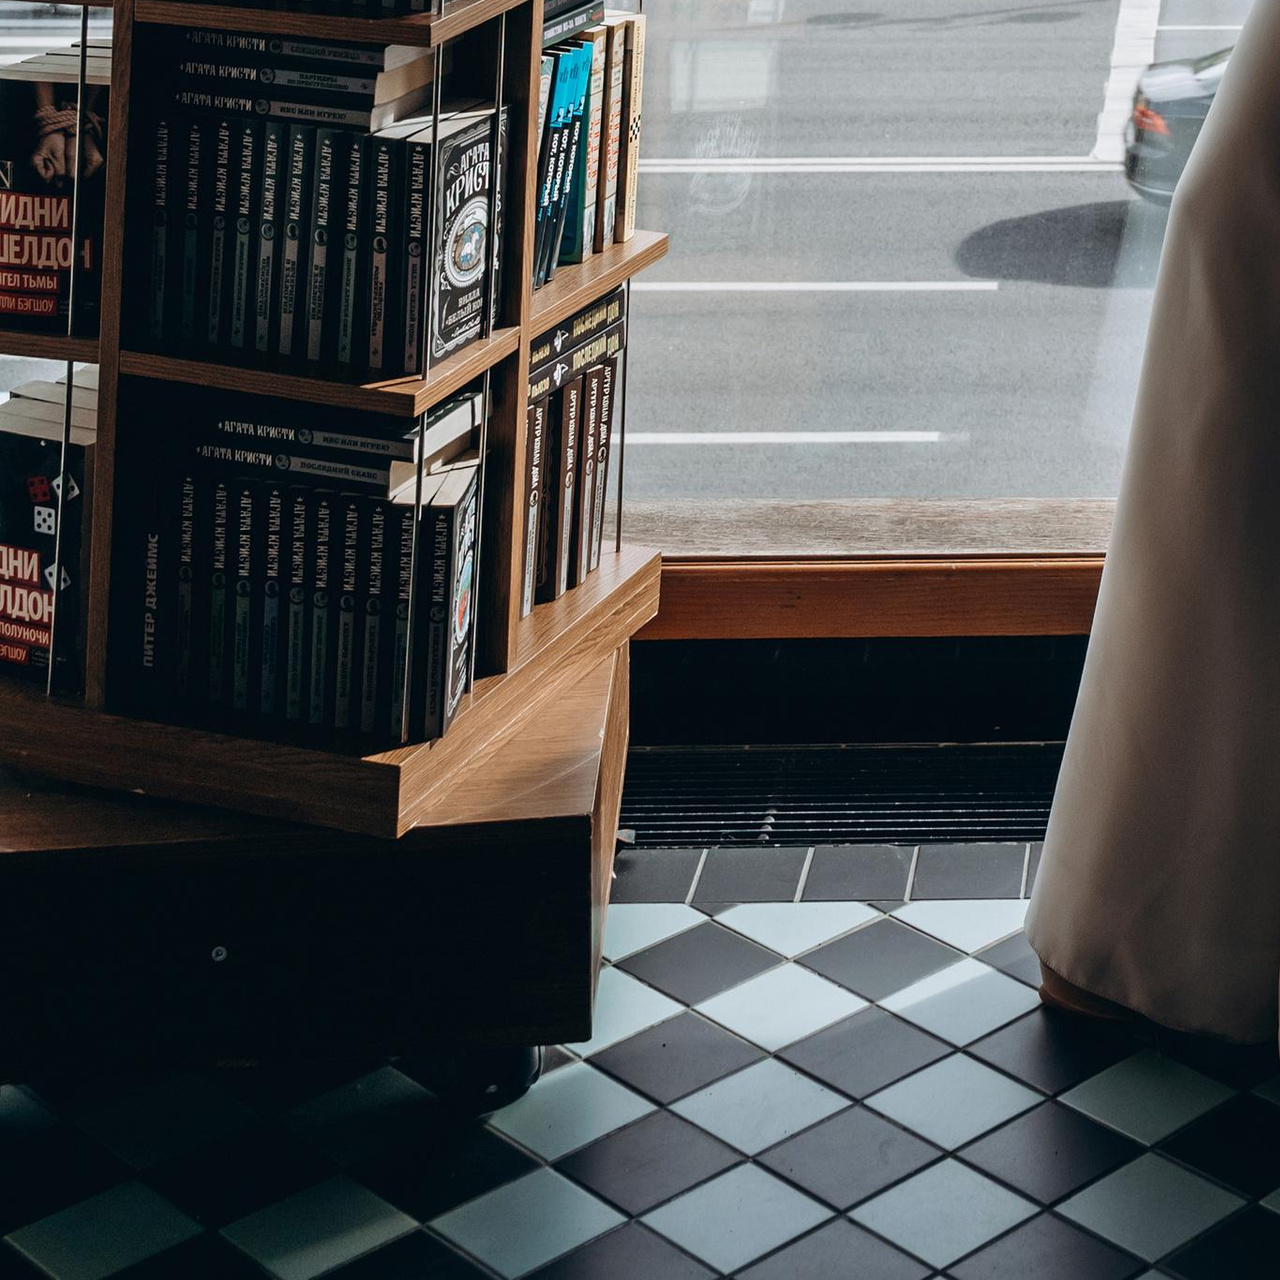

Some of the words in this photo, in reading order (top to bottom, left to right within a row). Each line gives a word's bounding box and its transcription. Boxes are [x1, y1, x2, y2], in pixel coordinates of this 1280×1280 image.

[185, 62, 216, 76] АГАТА
[219, 65, 257, 81] КРИСТИ
[181, 92, 212, 107] АГАТА
[214, 95, 252, 112] КРИСТИ
[550, 134, 559, 155] КОТ,
[560, 129, 569, 151] КОТ,
[572, 122, 581, 143] КОТ,
[264, 140, 278, 175] АГАТА
[292, 140, 304, 175] АГАТА
[319, 146, 332, 180] АГАТА
[349, 150, 361, 185] АГАТА
[376, 152, 389, 187] АГАТА
[411, 152, 423, 188] АГАТА
[460, 141, 490, 172] АГАТА
[262, 178, 276, 220] КРИСТИ
[289, 177, 302, 220] КРИСТИ
[317, 183, 330, 226] КРИСТИ
[446, 161, 490, 218] КРИСТ
[0, 194, 68, 230] ИДНИ
[346, 188, 359, 230] КРИСТИ
[375, 190, 387, 232] КРИСТИ
[409, 193, 422, 237] КРИСТИ
[23, 274, 57, 290] ТЬМЫ
[18, 297, 54, 312] БЭГШОУ
[573, 333, 607, 372] ПОСЛЕДНИЙ
[607, 333, 619, 358] ДОН
[223, 420, 254, 436] АГАТА
[257, 424, 295, 441] КРИСТИ
[201, 445, 232, 461] АГАТА
[234, 449, 273, 467] КРИСТИ
